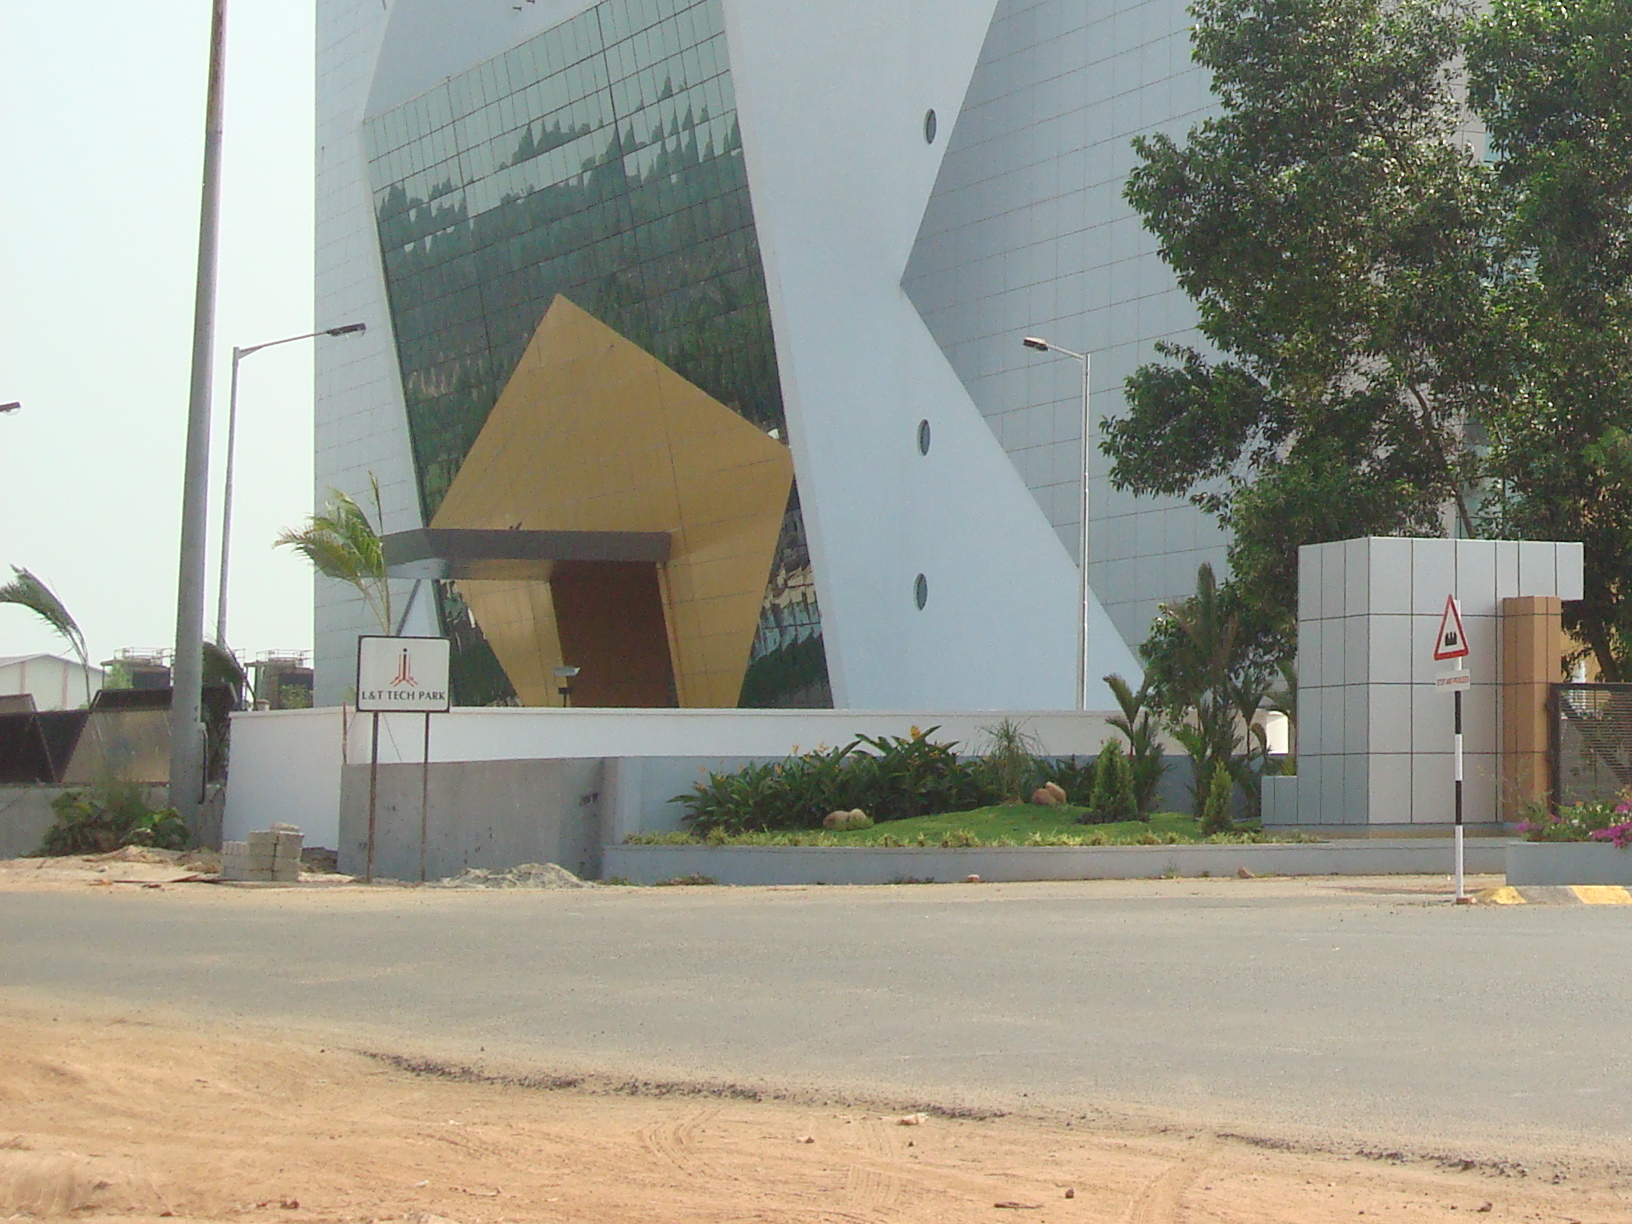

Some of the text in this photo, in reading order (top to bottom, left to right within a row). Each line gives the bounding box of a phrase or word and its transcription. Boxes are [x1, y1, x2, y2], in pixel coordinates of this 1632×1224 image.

[362, 690, 446, 701] L&T TECH PARK
